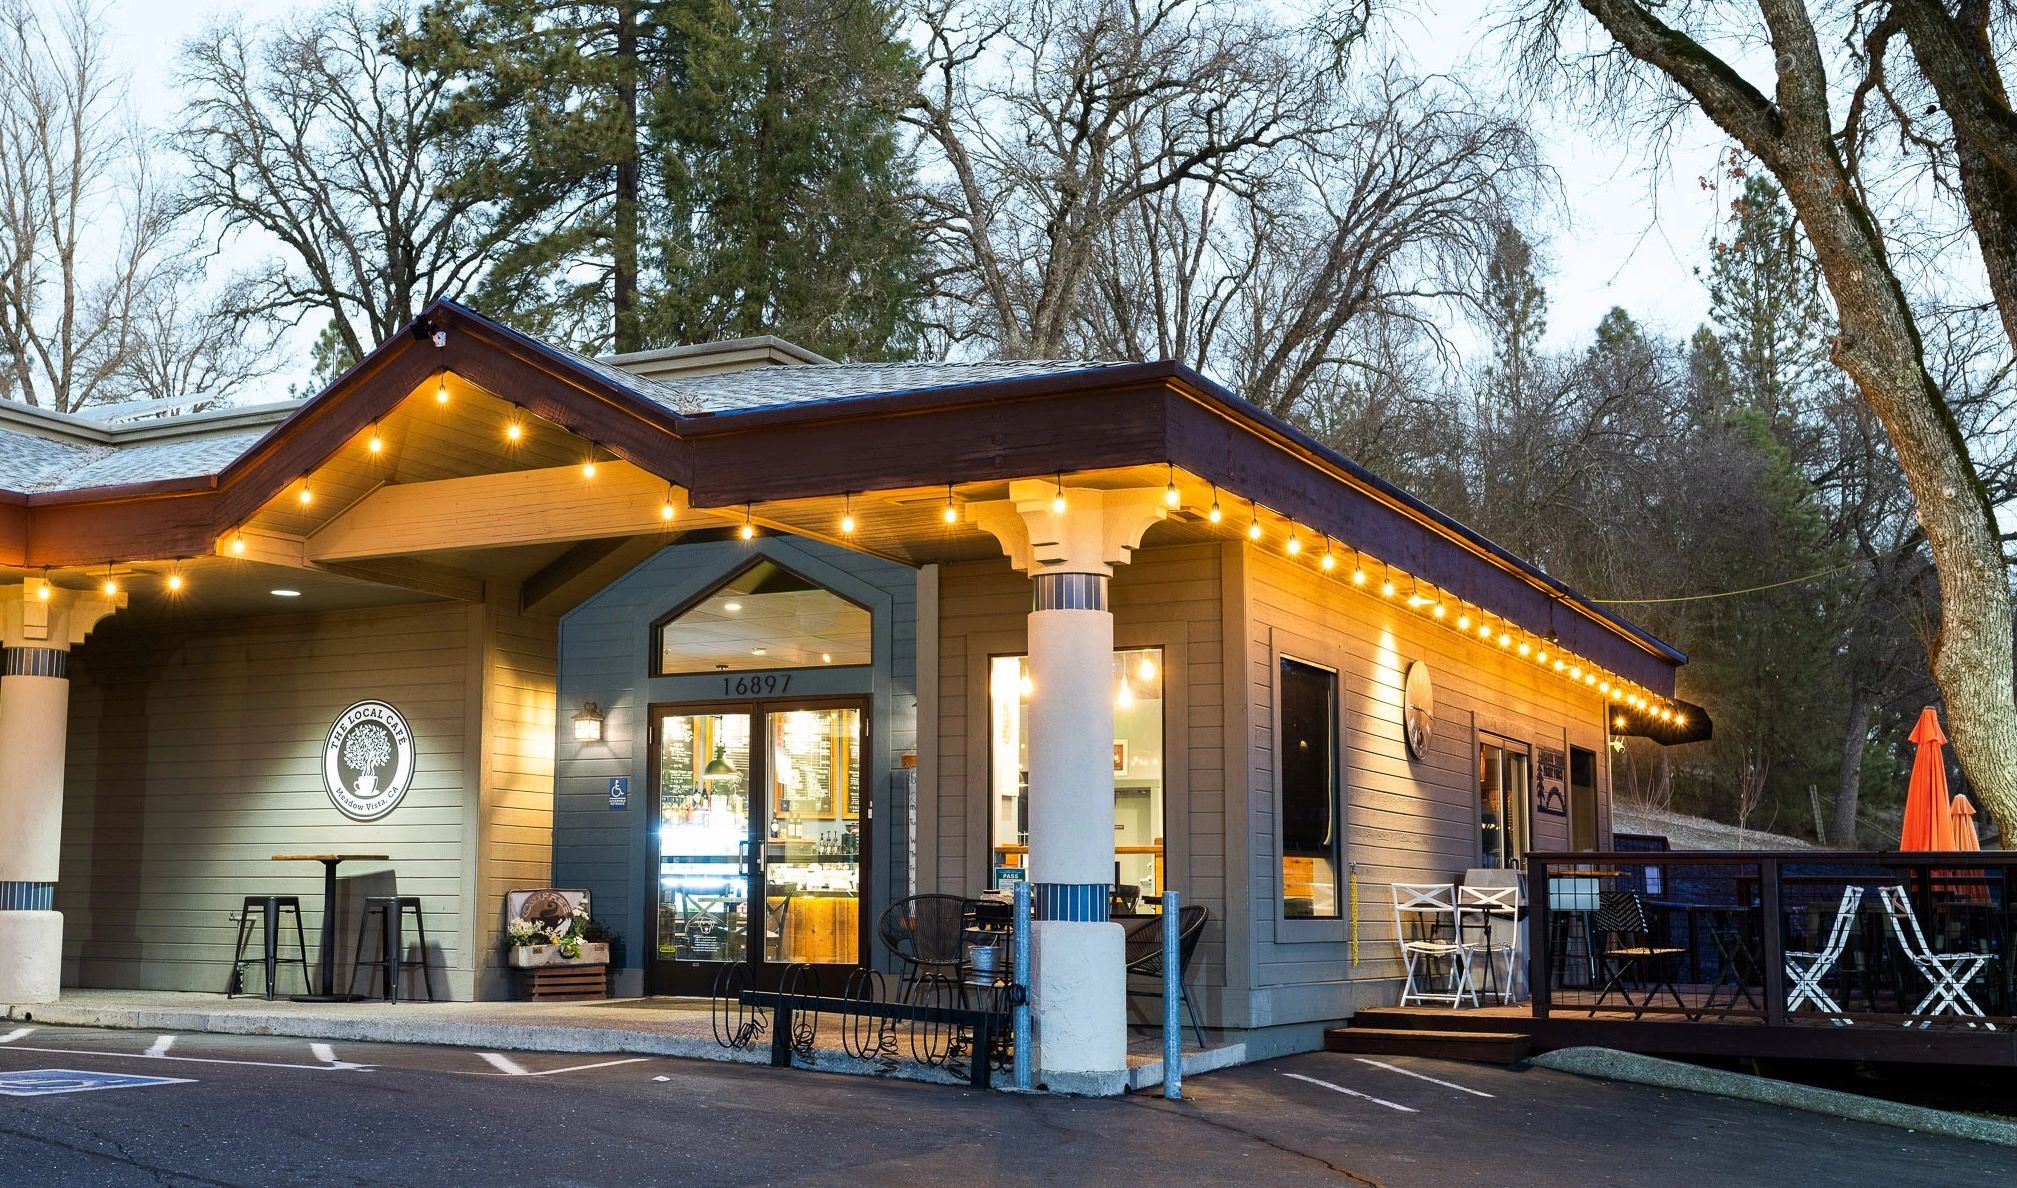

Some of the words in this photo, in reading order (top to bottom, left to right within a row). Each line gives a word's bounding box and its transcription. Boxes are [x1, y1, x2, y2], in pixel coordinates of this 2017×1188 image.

[723, 674, 791, 696] 16897
[331, 723, 347, 749] THE
[348, 708, 383, 725] LOCAL
[386, 715, 407, 745] CAFÉ
[336, 787, 364, 811] Meadow
[388, 786, 399, 798] CA
